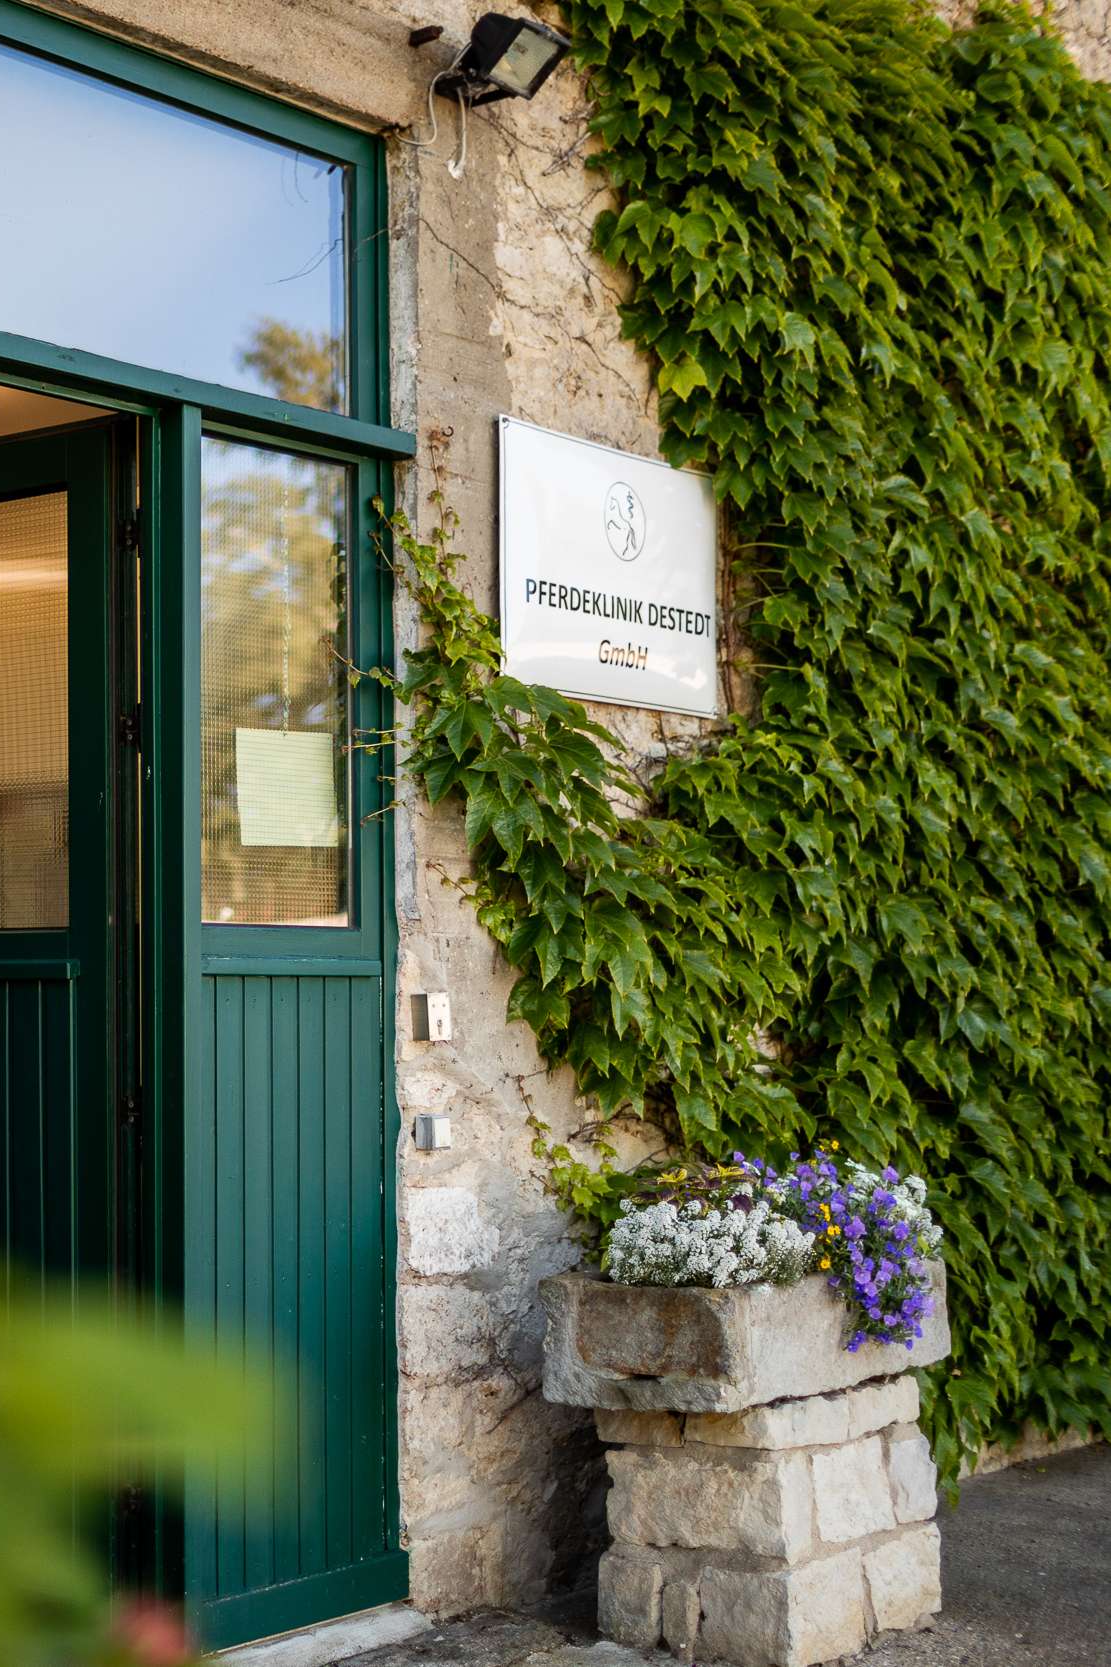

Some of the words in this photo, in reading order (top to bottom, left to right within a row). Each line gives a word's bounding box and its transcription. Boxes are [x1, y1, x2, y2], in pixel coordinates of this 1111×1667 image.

[526, 578, 643, 624] PFERDEKLINIK
[648, 603, 711, 637] DESTEDT
[598, 639, 648, 670] GmbH
